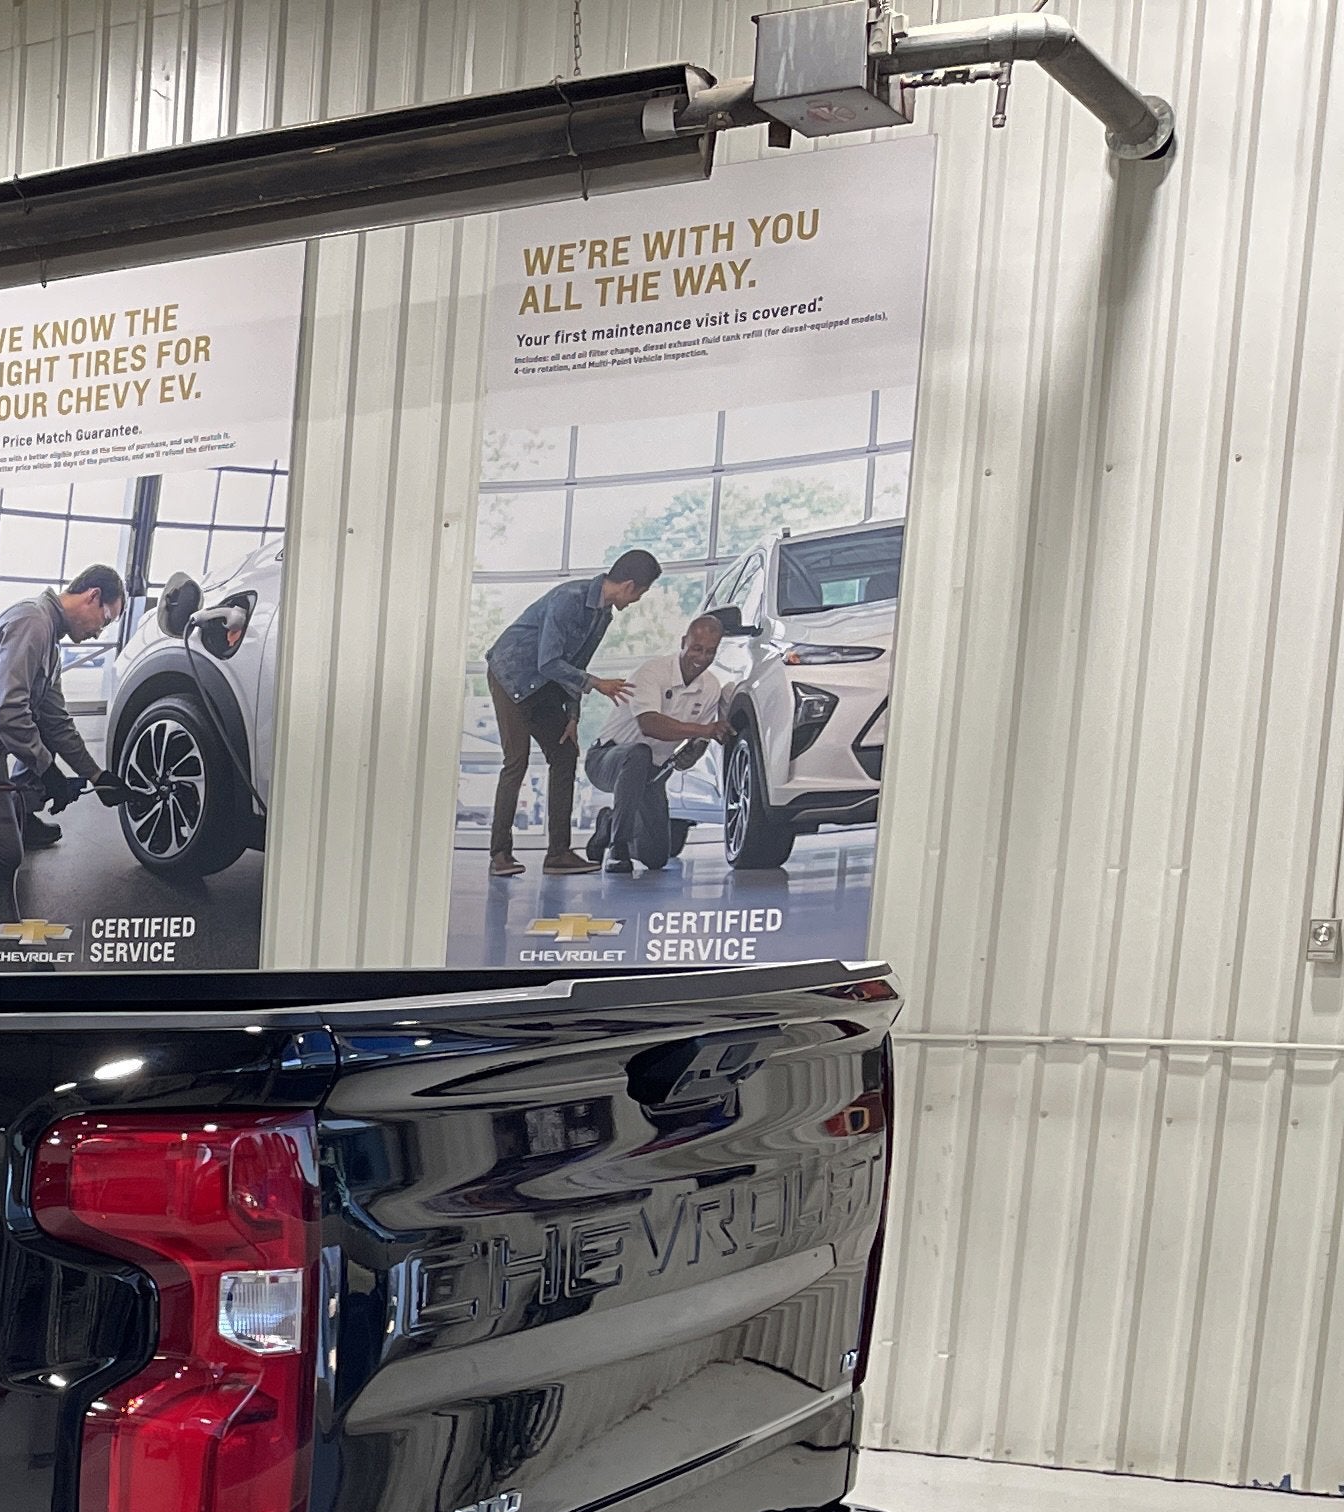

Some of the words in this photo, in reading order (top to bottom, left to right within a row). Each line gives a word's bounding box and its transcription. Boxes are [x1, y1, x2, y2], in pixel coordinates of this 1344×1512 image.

[522, 234, 631, 276] WE'RE
[642, 221, 735, 262] WITH
[747, 208, 820, 246] YOU
[518, 280, 583, 316] ALL
[594, 270, 661, 308] THE
[673, 258, 756, 298] WAY.
[32, 313, 115, 349] KNOW
[124, 304, 179, 337] THE
[516, 334, 550, 347] Your
[555, 330, 587, 344] first
[591, 318, 691, 340] maintenance
[695, 311, 729, 328] visit
[734, 309, 747, 323] is
[562, 351, 576, 360] and
[589, 349, 609, 358] filter
[610, 346, 641, 356] change,
[643, 342, 667, 352] diesel
[668, 339, 700, 349] exhaust
[702, 335, 720, 345] fluid
[722, 333, 741, 343] tank
[743, 330, 762, 340] refill
[764, 327, 779, 338] (for
[782, 318, 850, 334] diesel-equipped
[68, 344, 146, 380] TIRES
[156, 335, 211, 368] FOR
[514, 365, 536, 375] 4-tire
[537, 363, 570, 373] rotation,
[572, 361, 586, 370] and
[588, 357, 631, 369] Multi-Point
[634, 353, 662, 364] Vehicle
[664, 349, 708, 361] Inspection.
[57, 379, 152, 416] CHEVY
[160, 372, 202, 404] EV.
[2, 435, 32, 448] Price
[36, 430, 72, 445] Match
[76, 425, 142, 441] Guarantee.
[62, 459, 77, 468] days
[91, 917, 196, 939] CERTIFIED
[519, 950, 627, 962] CHEVROLET
[648, 908, 783, 934] CERTIFIED
[645, 937, 757, 961] SERVICE
[89, 941, 176, 963] SERVICE
[403, 1145, 884, 1338] CHEVROLET
